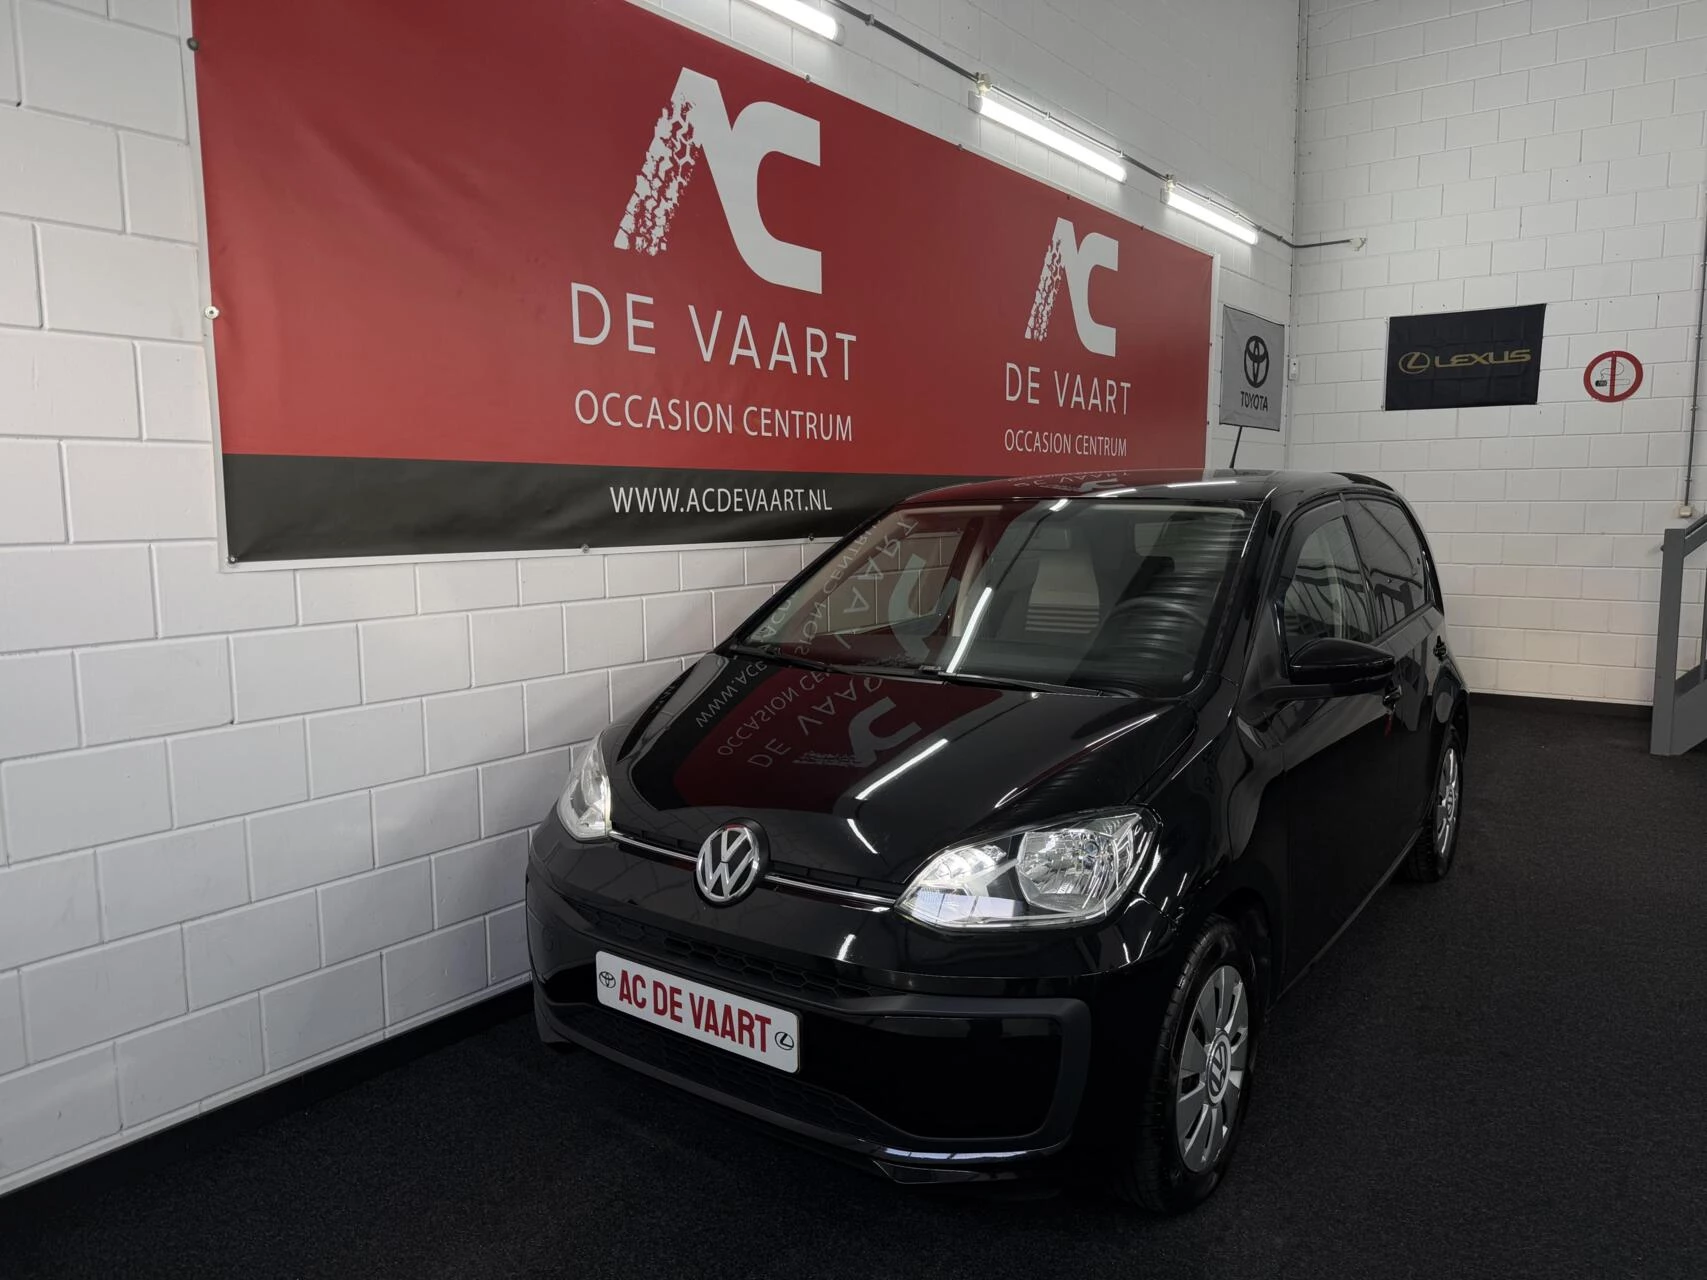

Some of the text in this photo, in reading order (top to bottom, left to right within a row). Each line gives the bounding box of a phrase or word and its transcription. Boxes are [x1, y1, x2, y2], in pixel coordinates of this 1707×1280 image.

[571, 282, 857, 381] DE VAART
[1434, 349, 1532, 368] LEXUS
[1006, 362, 1131, 415] DE VAART
[1240, 390, 1269, 413] TOYOTA
[574, 389, 853, 442] OCCASION CENTRUM
[1004, 428, 1127, 457] OCCASION CENTRUM
[609, 486, 833, 513] WWW.ACDEVAART.NL
[618, 969, 772, 1053] AC DE VAART
